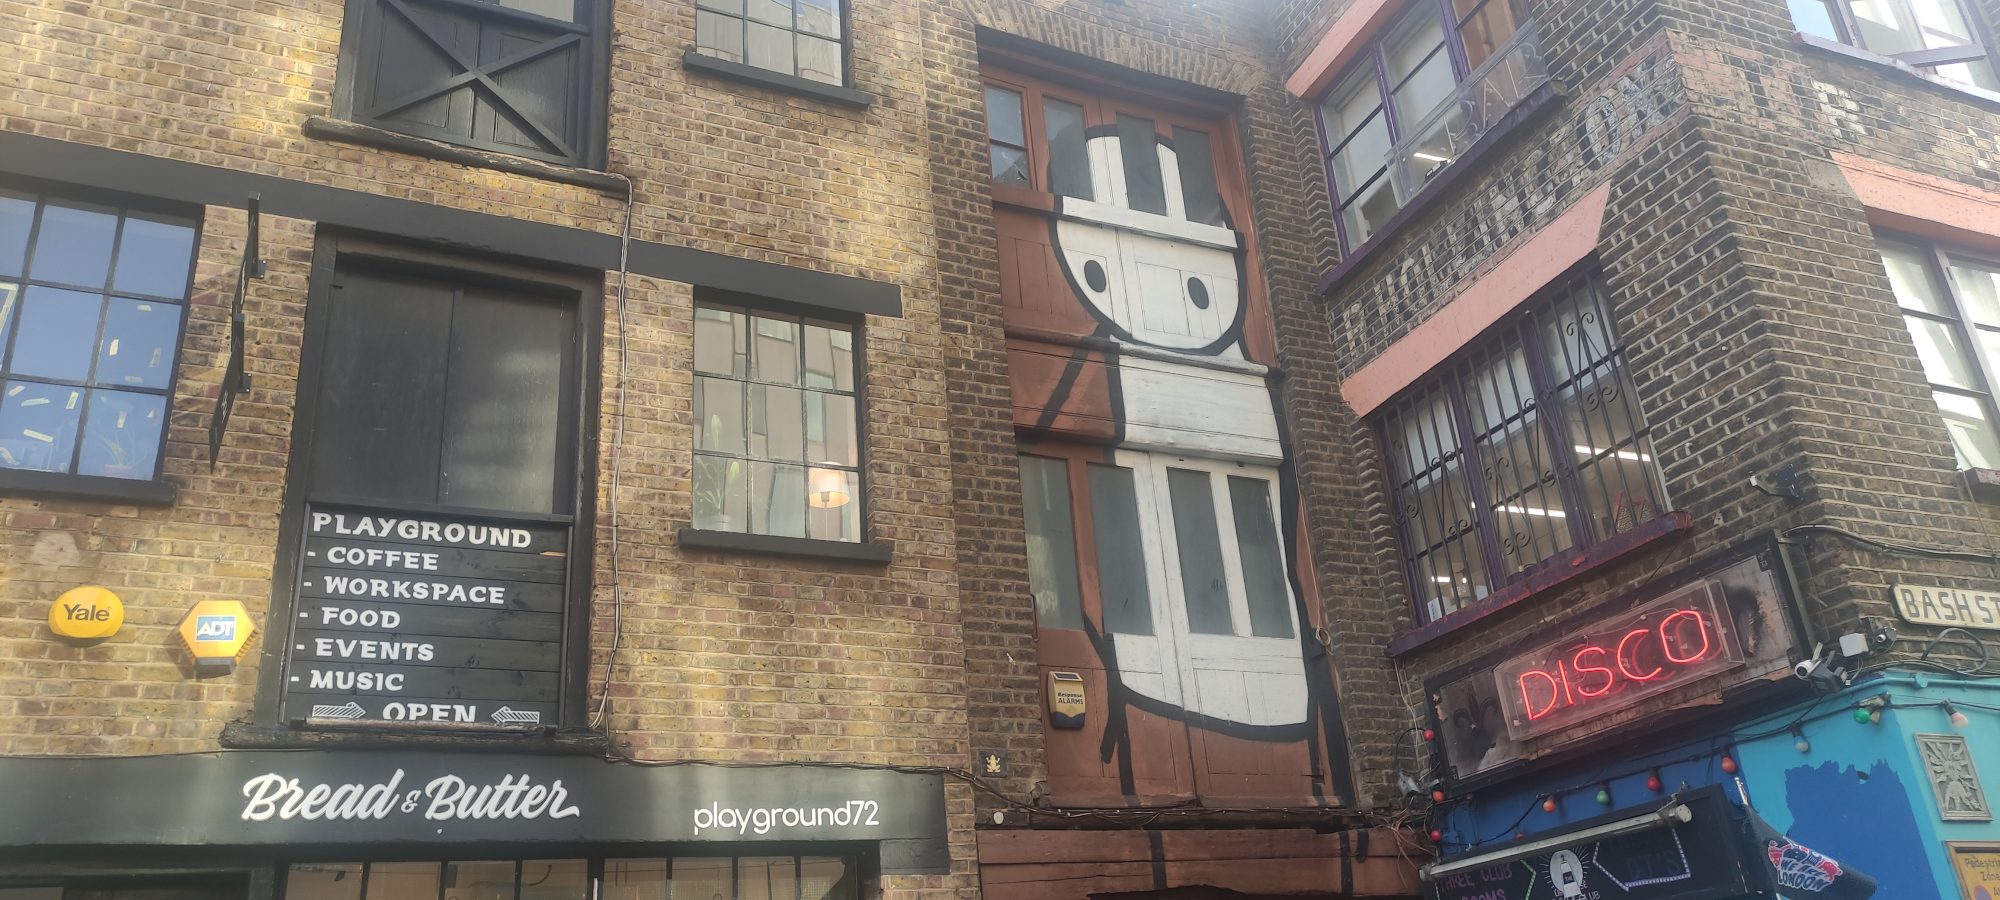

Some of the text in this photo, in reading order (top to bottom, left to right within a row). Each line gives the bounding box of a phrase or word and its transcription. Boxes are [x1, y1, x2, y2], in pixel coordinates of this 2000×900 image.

[312, 512, 532, 548] PLAYGROUND
[327, 547, 440, 571] COFFEE
[323, 575, 506, 605] WORKSPACE
[63, 604, 110, 622] Yale
[321, 606, 401, 629] FOOD
[1900, 588, 1976, 623] BASH
[197, 620, 235, 636] ADT
[315, 637, 435, 662] EVENTS
[1518, 609, 1711, 721] DISCO
[309, 669, 405, 692] MUSIC
[382, 702, 477, 723] OPEN
[1058, 697, 1084, 705] ALARMS
[241, 767, 580, 822] Bread & Butter
[693, 799, 881, 836] playground72
[1780, 857, 1827, 878] WE ARE
[1964, 856, 2000, 868] Pedestri
[1777, 868, 1830, 892] LONDON
